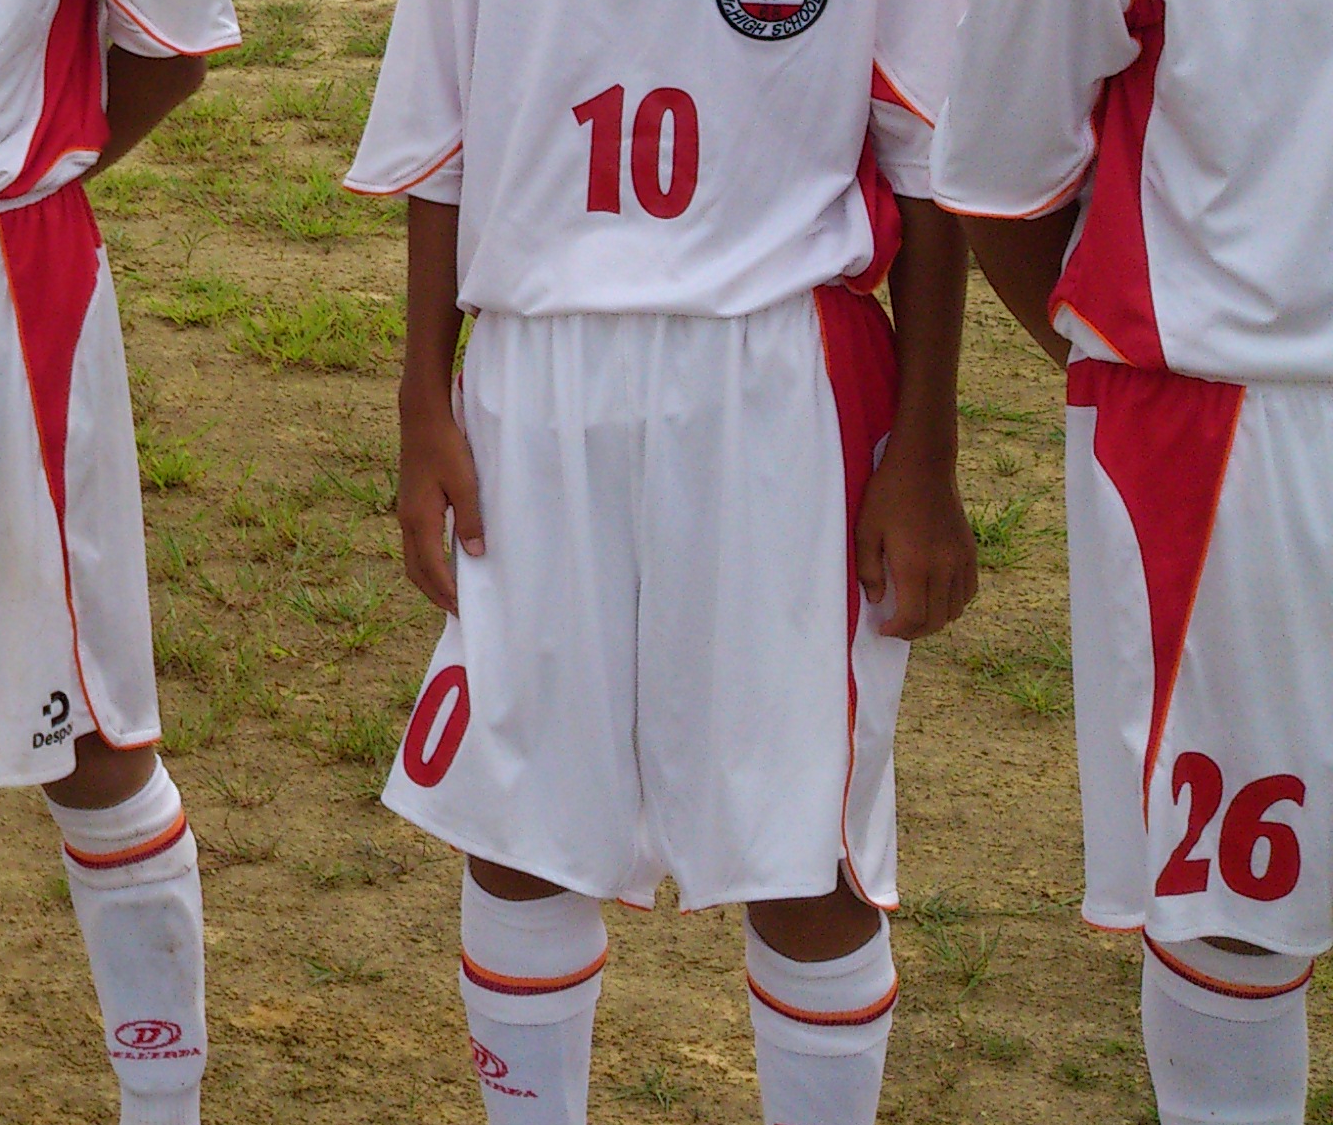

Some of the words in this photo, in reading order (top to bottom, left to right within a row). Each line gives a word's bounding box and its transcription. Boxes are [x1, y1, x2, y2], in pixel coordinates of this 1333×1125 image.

[571, 83, 700, 220] 10
[403, 664, 471, 788] 0
[1154, 751, 1307, 902] 26
